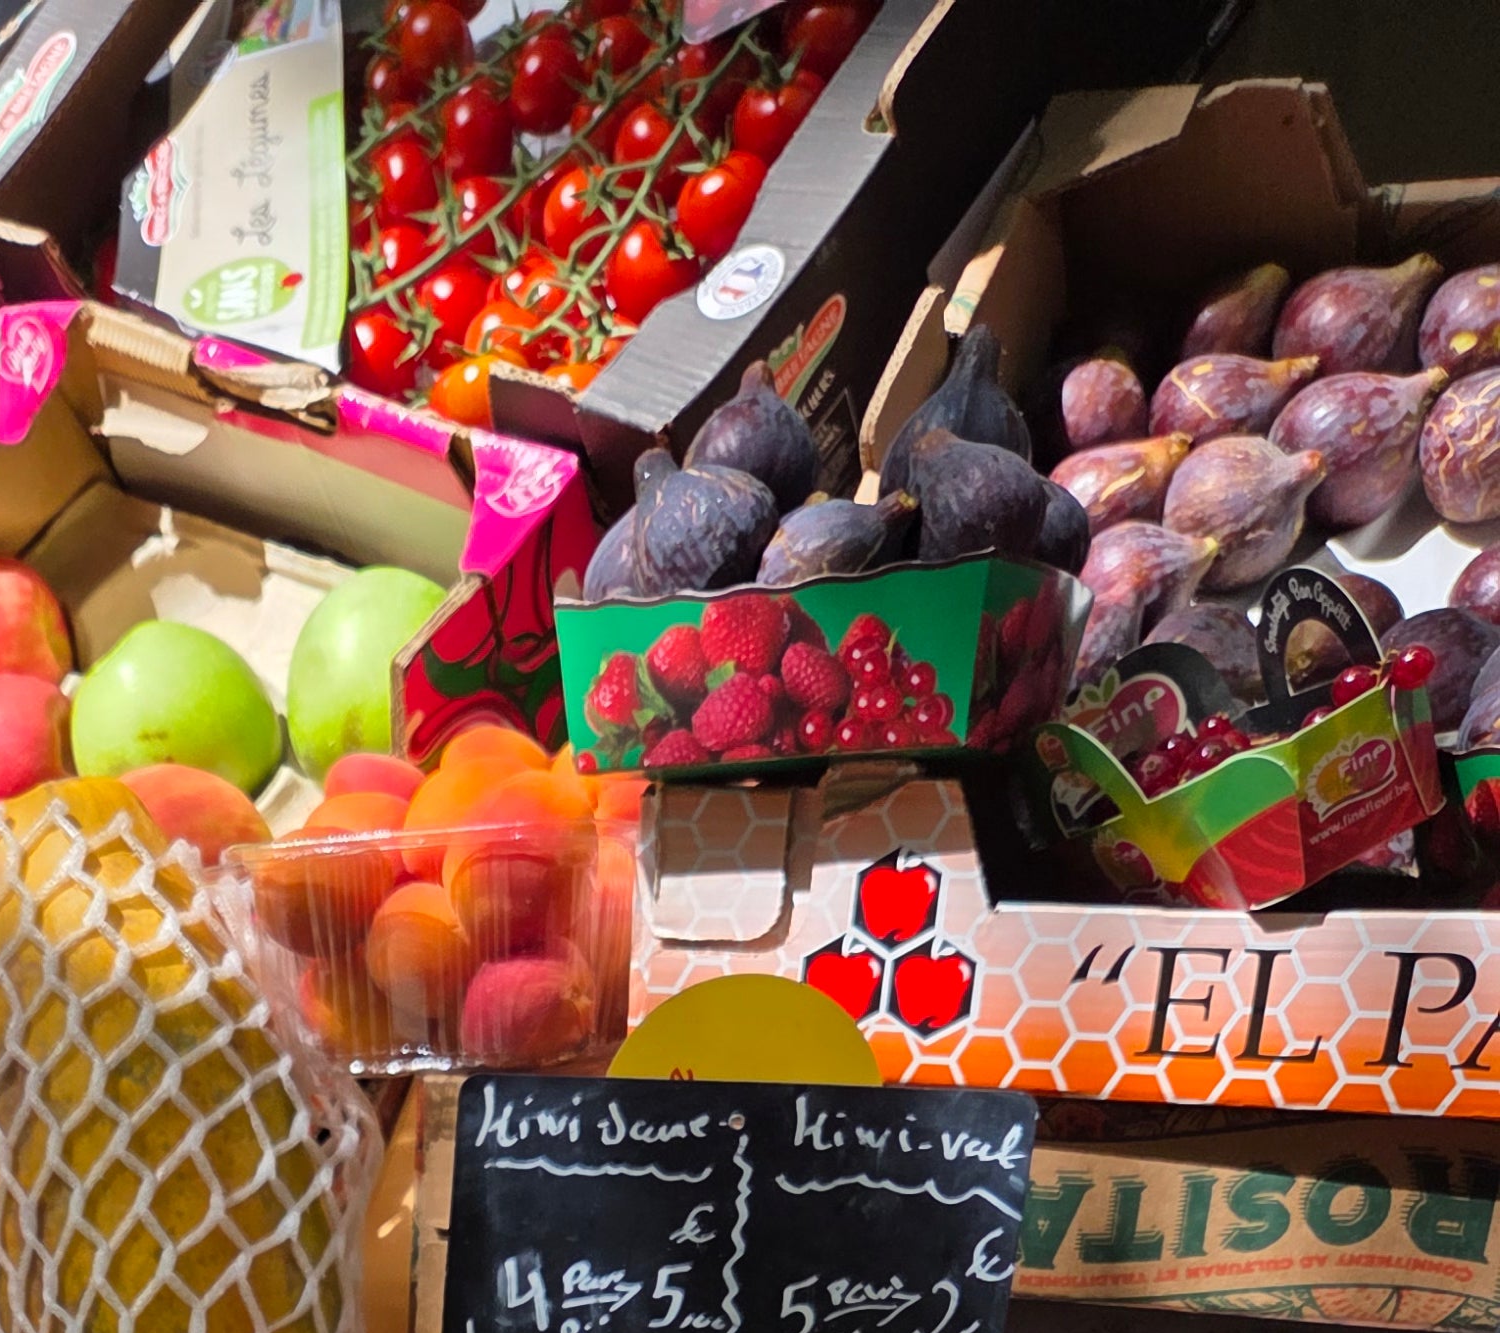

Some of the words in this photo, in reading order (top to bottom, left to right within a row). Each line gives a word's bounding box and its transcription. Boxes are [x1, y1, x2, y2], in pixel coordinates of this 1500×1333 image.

[230, 71, 283, 188] Légumes
[231, 199, 277, 247] Les
[1287, 576, 1314, 602] Bon
[1337, 743, 1388, 780] Fine
[474, 1080, 584, 1150] Kiwi
[668, 1203, 717, 1246] €
[965, 1225, 1017, 1284] €
[1153, 1267, 1180, 1284] ET
[501, 1254, 551, 1332] 4
